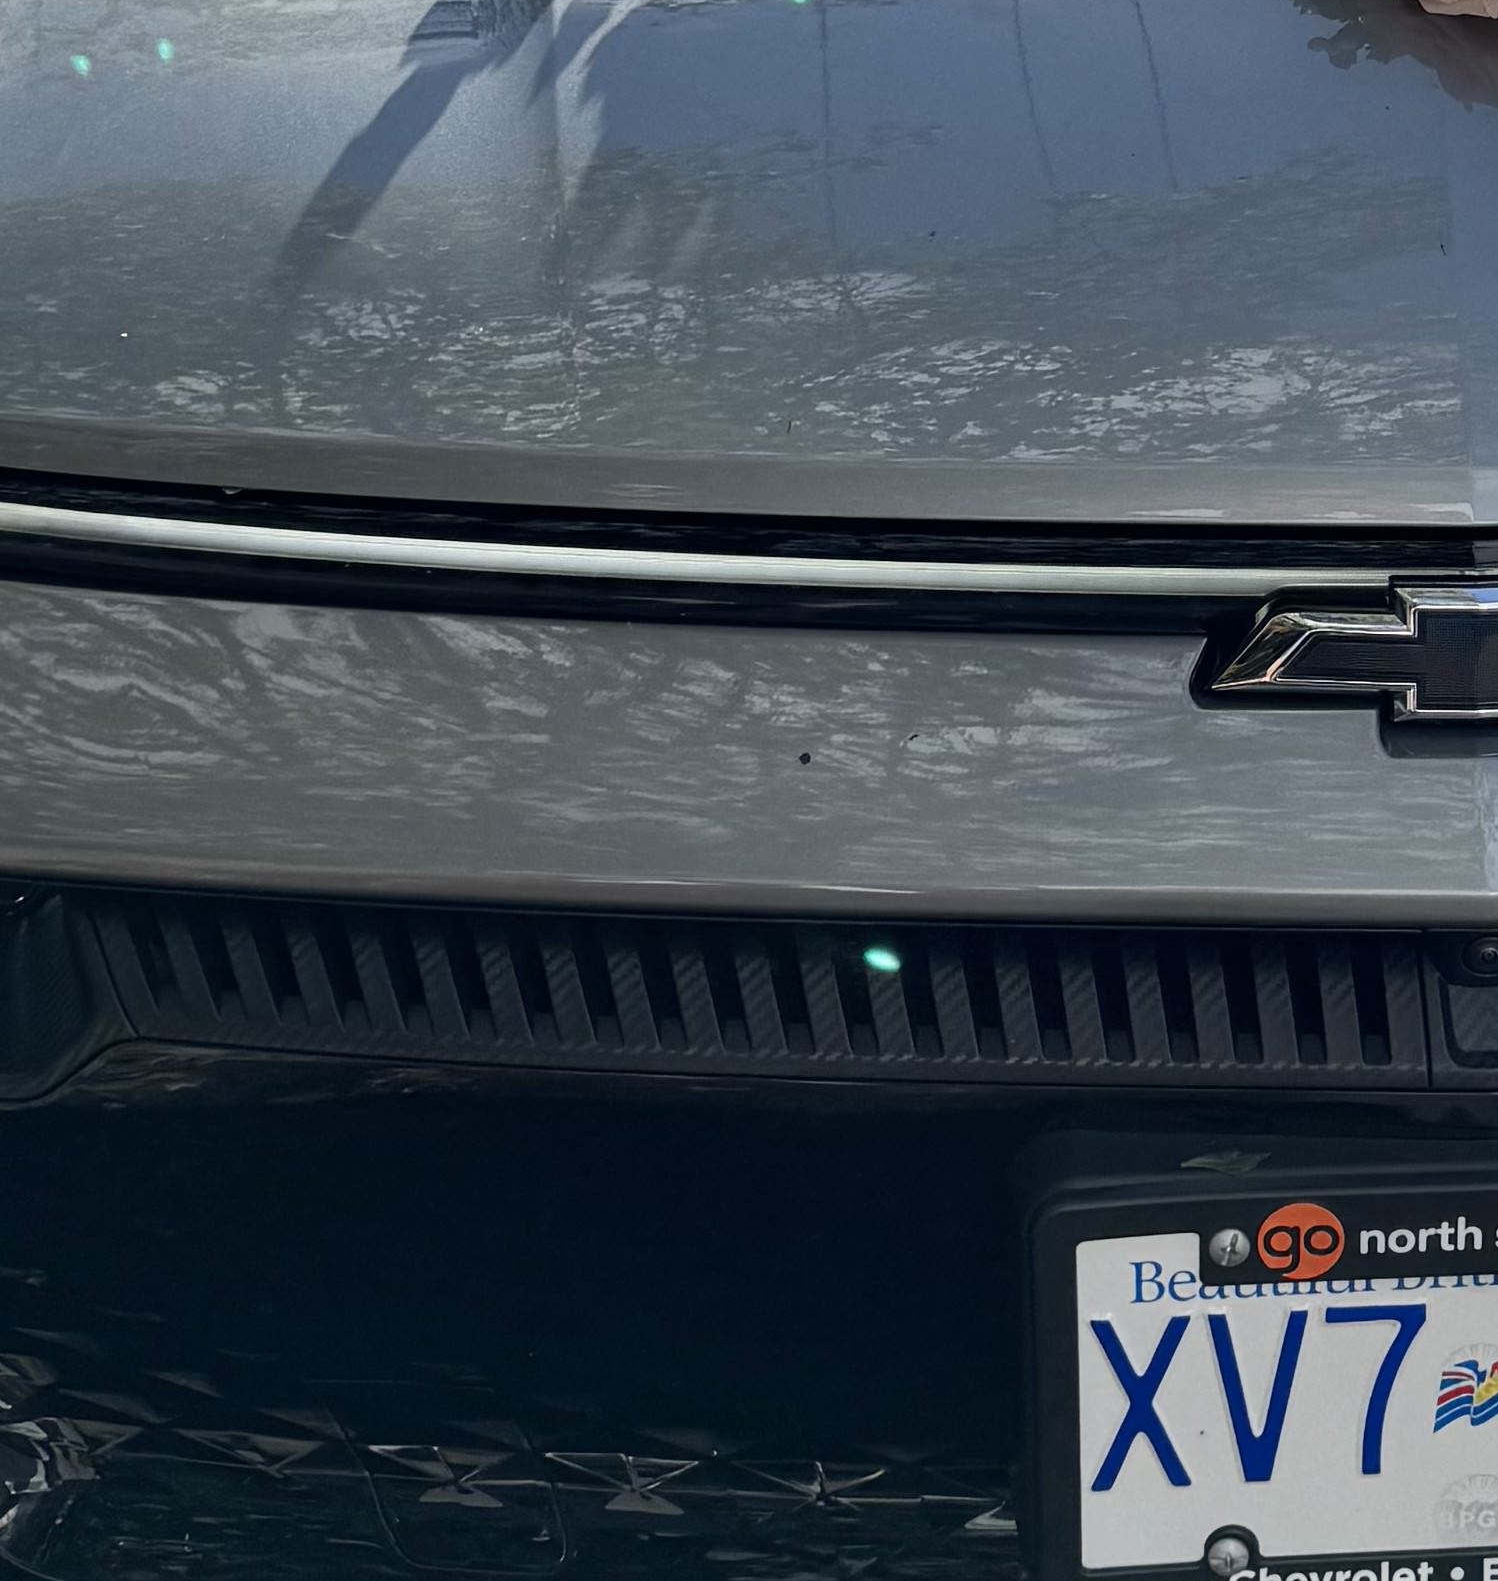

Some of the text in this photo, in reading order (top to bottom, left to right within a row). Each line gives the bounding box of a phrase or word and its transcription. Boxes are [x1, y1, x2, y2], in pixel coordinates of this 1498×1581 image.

[1263, 1225, 1340, 1276] go
[1359, 1216, 1483, 1256] north
[1089, 1303, 1428, 1493] XV7
